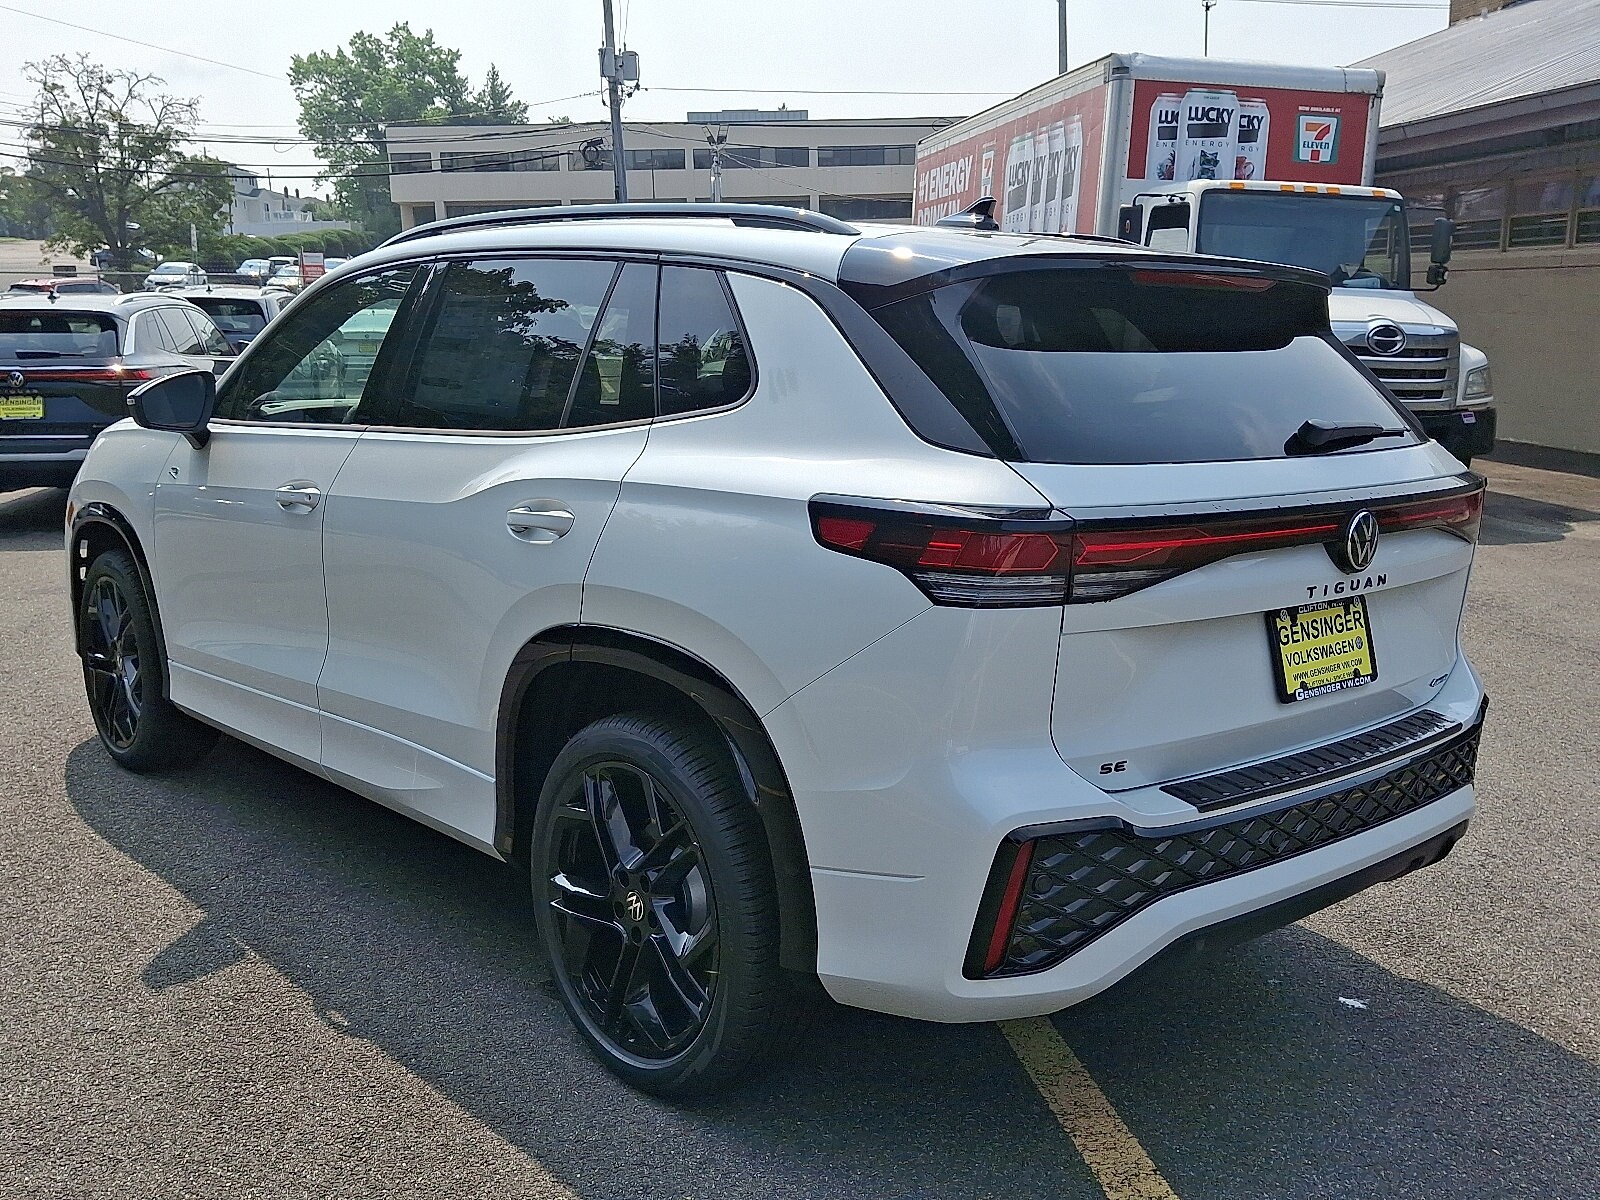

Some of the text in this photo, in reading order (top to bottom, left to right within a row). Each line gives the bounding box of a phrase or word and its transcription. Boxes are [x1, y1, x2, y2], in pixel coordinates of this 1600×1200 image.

[1159, 110, 1179, 124] LUC
[1187, 106, 1234, 124] LUCKY
[1239, 114, 1264, 129] CKY
[1185, 140, 1230, 148] ENERGY
[929, 155, 973, 201] ENERGY
[1306, 573, 1387, 599] TIGUAN
[1279, 609, 1364, 646] GENSINGER
[1285, 638, 1354, 667] VOLKSWAGEN
[1099, 760, 1128, 775] SE
